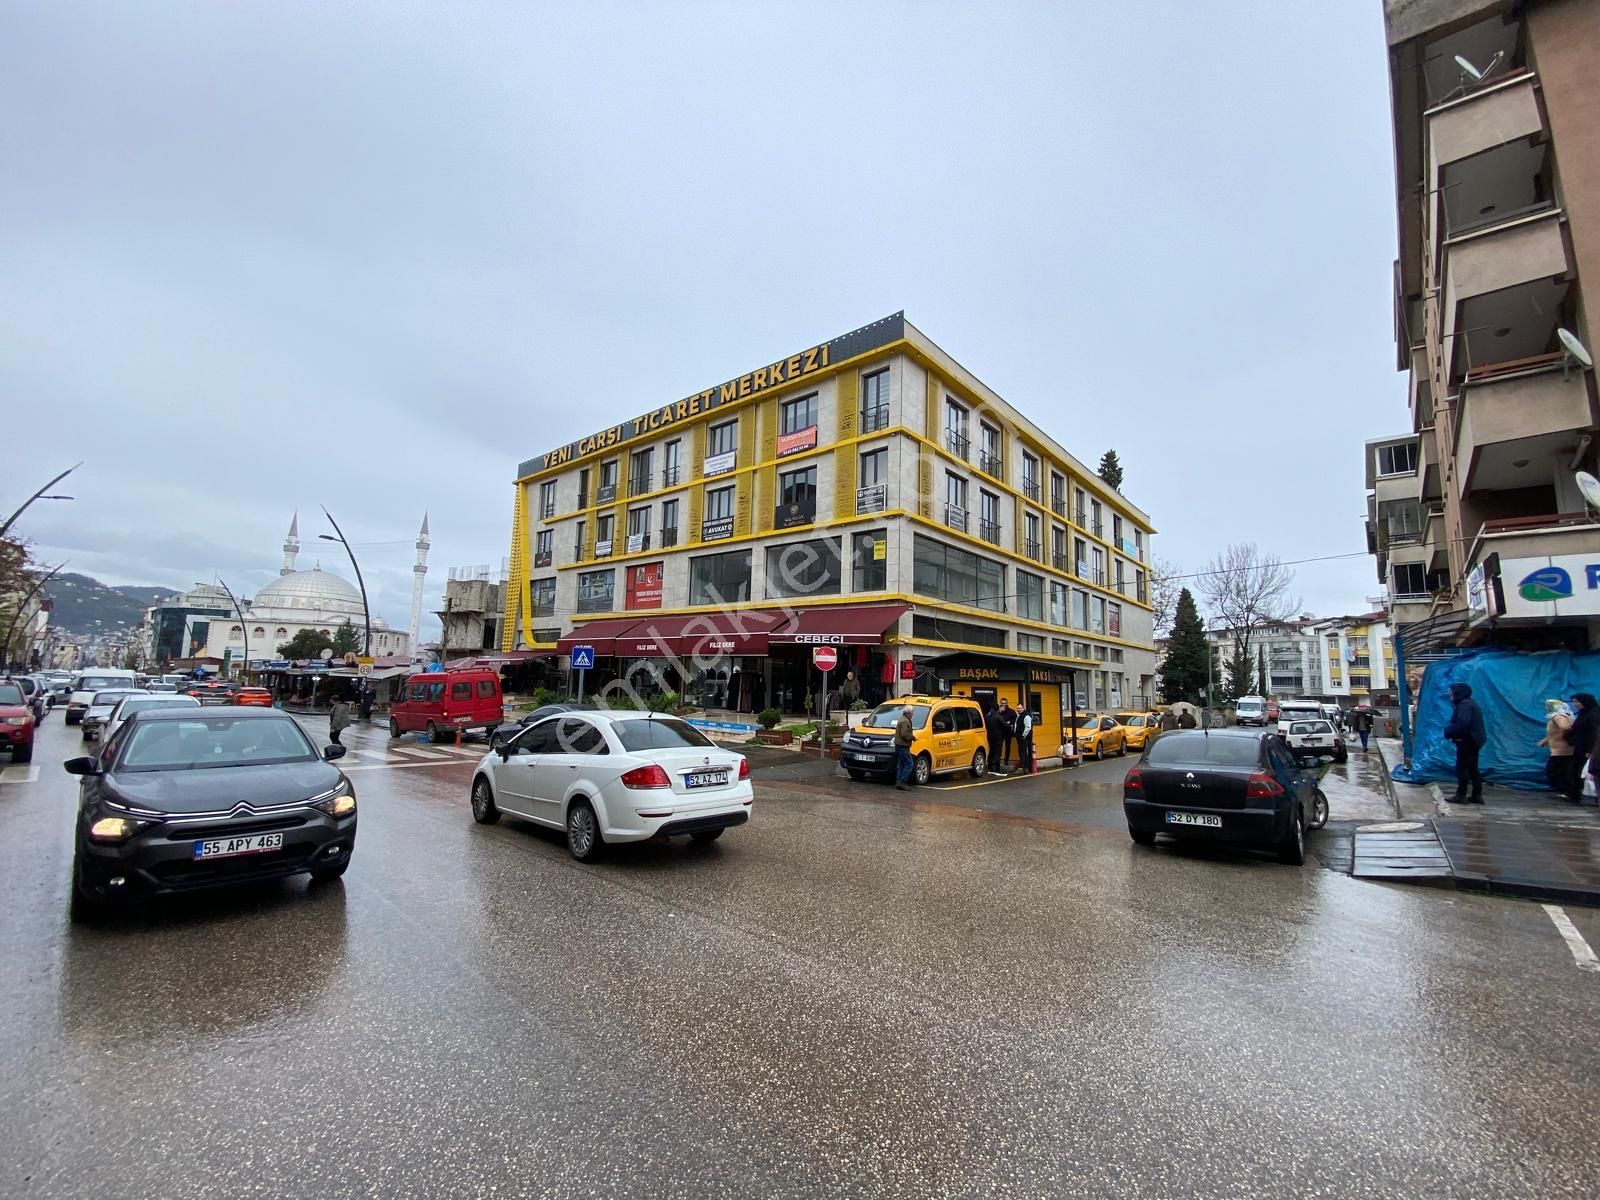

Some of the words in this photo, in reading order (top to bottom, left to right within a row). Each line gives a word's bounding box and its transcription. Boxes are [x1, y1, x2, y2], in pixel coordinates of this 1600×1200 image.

[708, 525, 728, 534] AVUKAT
[960, 668, 998, 681] BAŞAK
[690, 775, 700, 785] 52
[702, 774, 712, 783] AZ
[715, 772, 727, 782] 174
[1171, 813, 1183, 822] 52
[1186, 814, 1199, 823] DY
[1202, 816, 1219, 826] 180
[203, 842, 220, 855] 55
[226, 838, 252, 852] APY
[258, 834, 282, 848] 463
